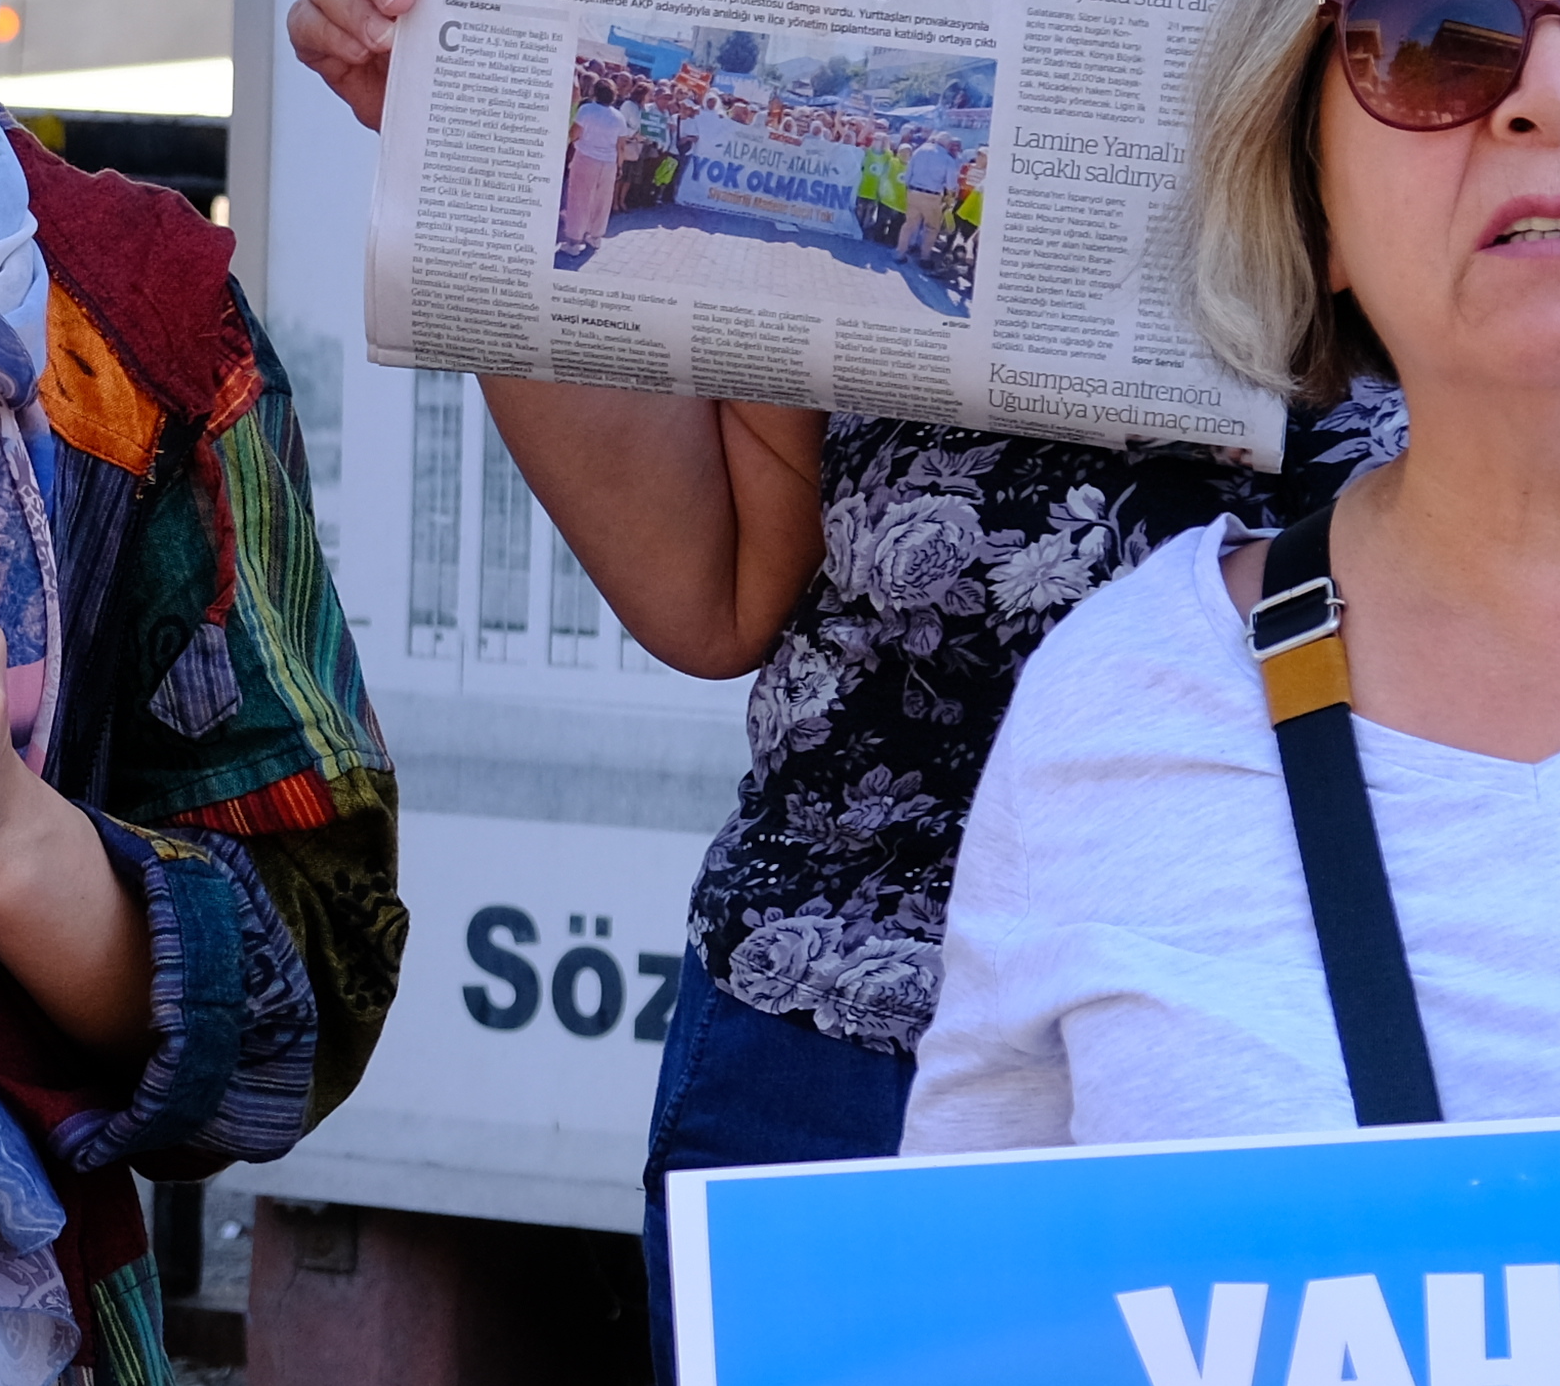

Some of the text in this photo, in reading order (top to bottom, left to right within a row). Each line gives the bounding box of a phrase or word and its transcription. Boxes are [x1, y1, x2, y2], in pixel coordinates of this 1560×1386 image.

[786, 1, 820, 15] damga
[859, 9, 912, 23] Yurttaşları
[754, 15, 765, 23] ve
[788, 17, 828, 30] yönetim
[939, 35, 972, 47] ortaya
[723, 140, 829, 176] ALPAGUT-ATALAN
[1013, 127, 1098, 154] Lamine
[691, 154, 745, 189] YOK
[1012, 153, 1177, 192] bıçaklı saldırıya
[1132, 356, 1153, 365] Spor
[989, 363, 1221, 409] Kasımpaşa antrenörü
[988, 389, 1088, 421] Uğurlu'ya
[1090, 405, 1140, 429] yedi
[1140, 411, 1190, 435] maç
[1194, 417, 1246, 436] men
